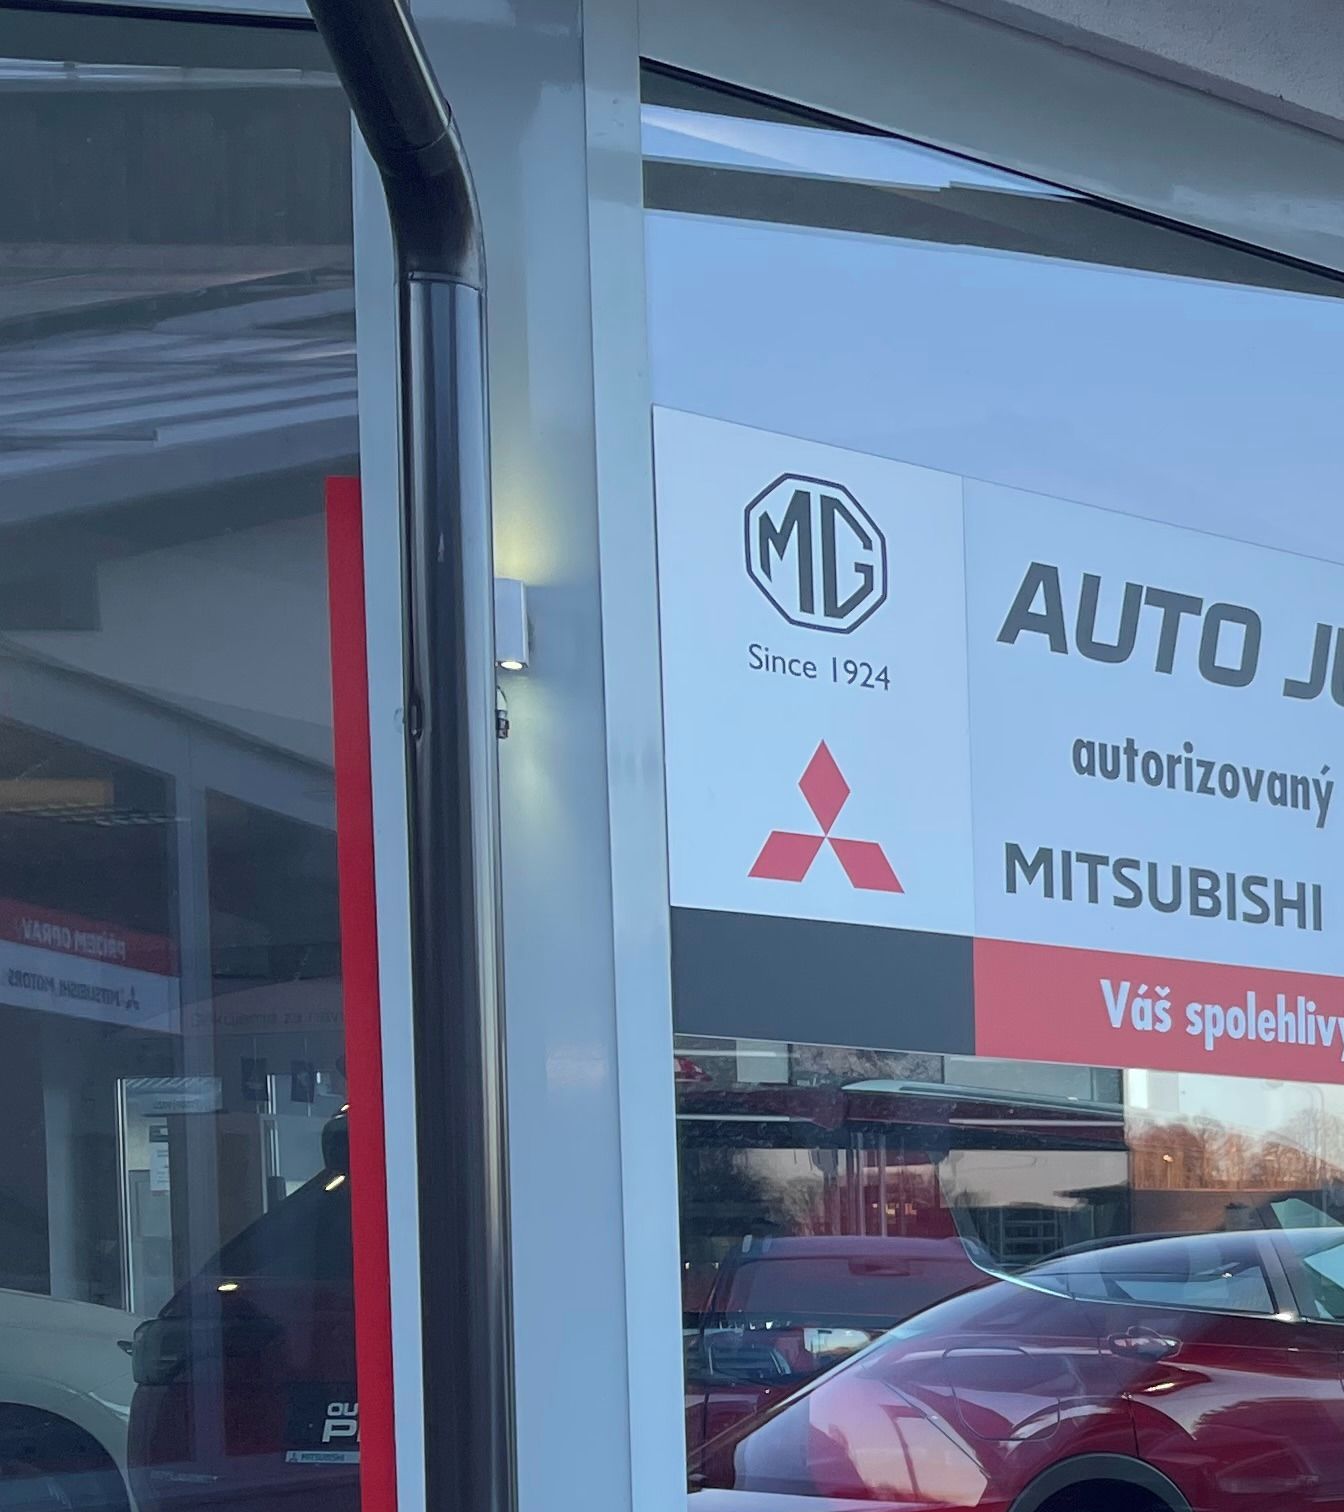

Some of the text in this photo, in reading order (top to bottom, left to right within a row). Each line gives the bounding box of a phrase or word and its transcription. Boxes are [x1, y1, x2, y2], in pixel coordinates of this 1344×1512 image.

[756, 484, 879, 626] MG
[748, 643, 890, 691] Since 1924
[996, 562, 1262, 688] AUTO
[1072, 737, 1334, 828] autorizovaný
[1004, 842, 1322, 931] MITSUBISHI
[1100, 979, 1171, 1033] Váš
